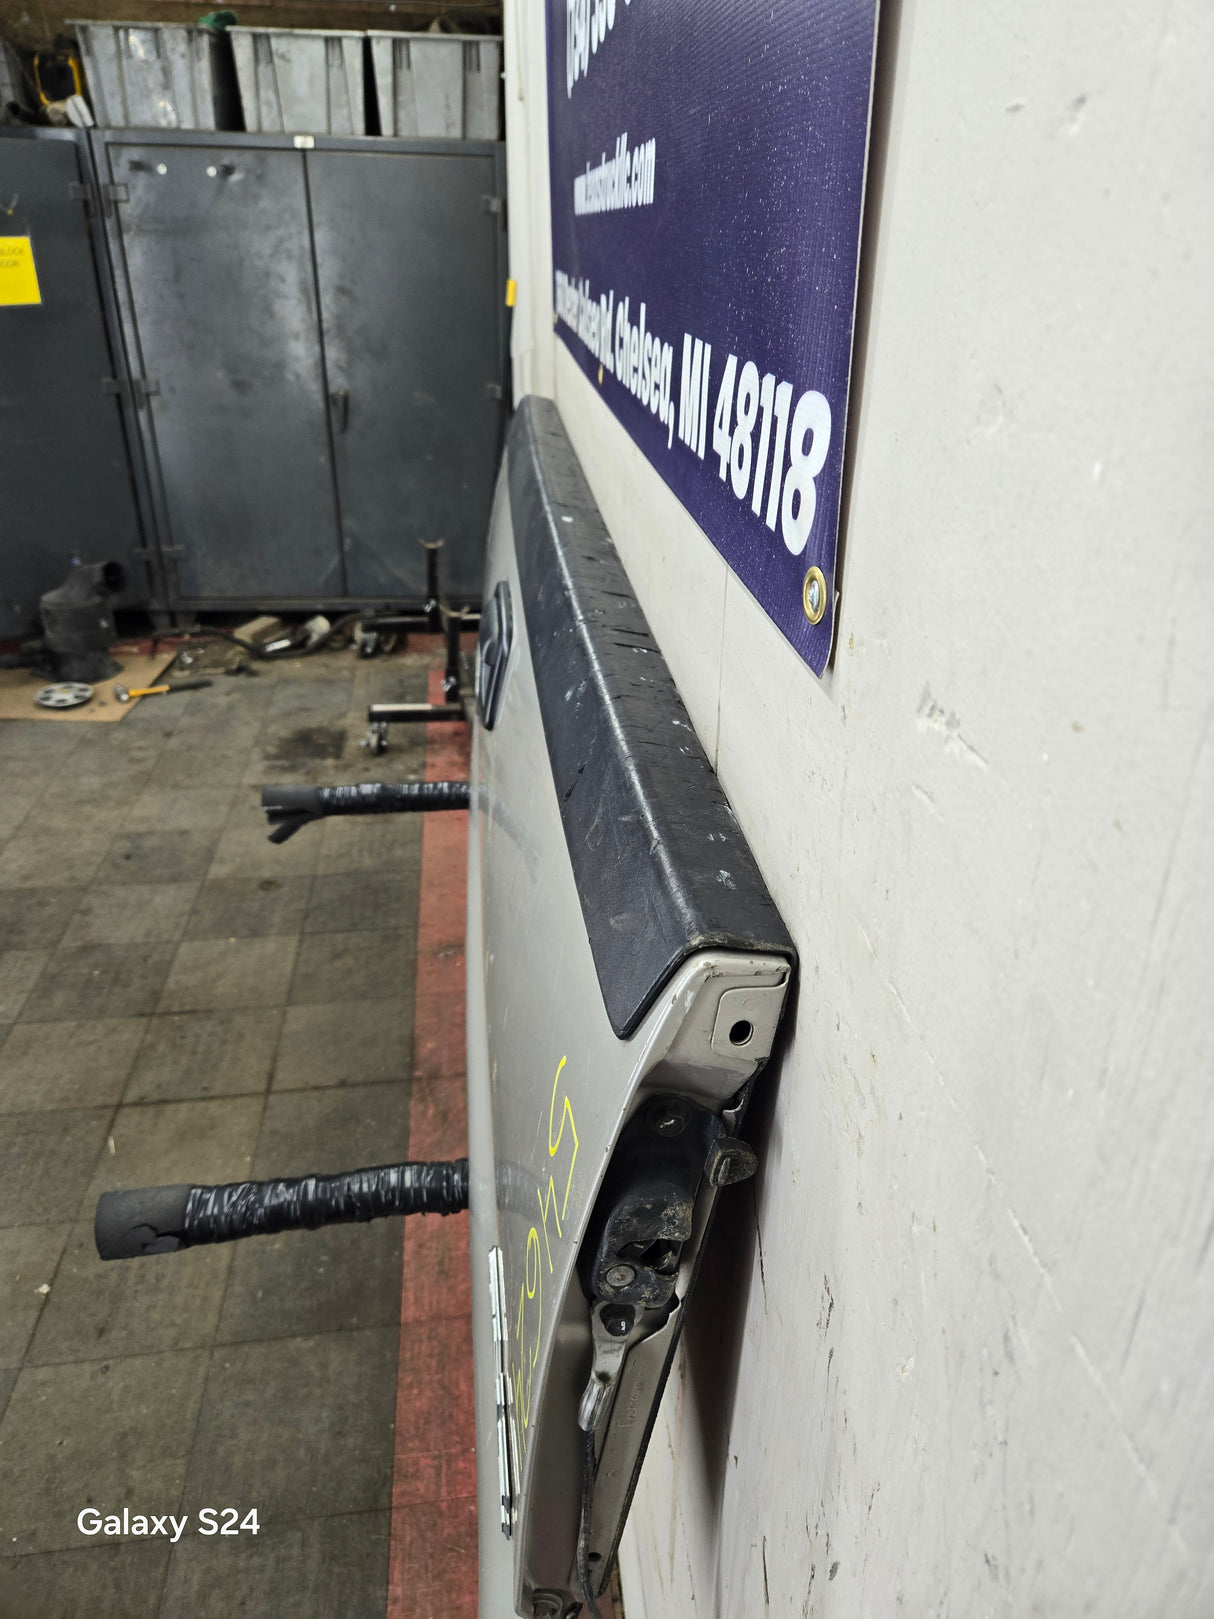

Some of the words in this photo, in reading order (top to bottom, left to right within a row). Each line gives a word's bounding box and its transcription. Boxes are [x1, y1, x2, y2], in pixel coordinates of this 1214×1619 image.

[615, 296, 675, 449] Chelsea,
[678, 332, 712, 460] MI
[712, 353, 832, 556] 48118
